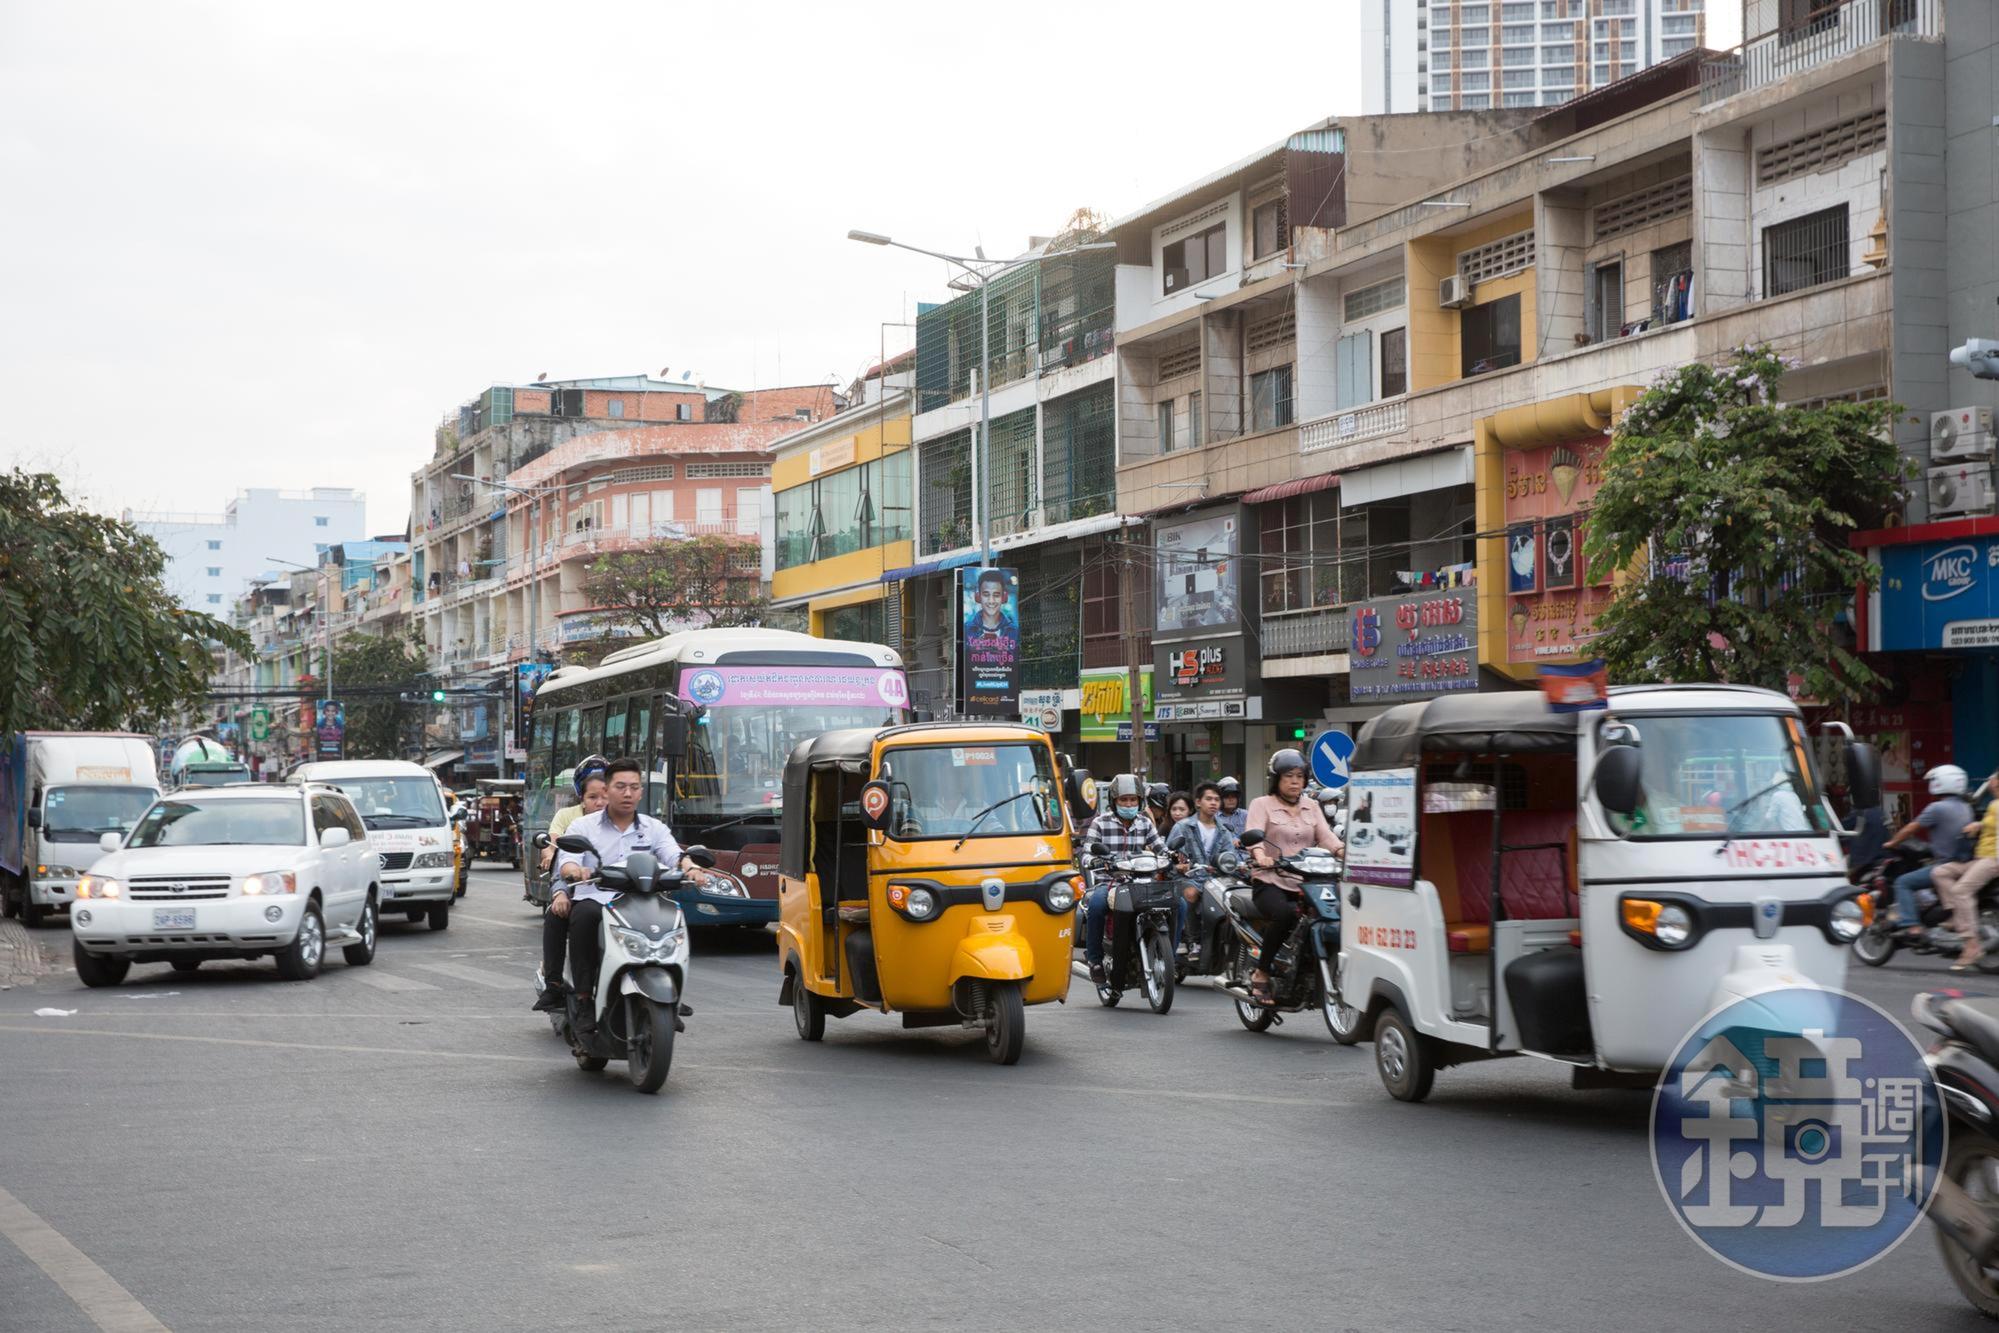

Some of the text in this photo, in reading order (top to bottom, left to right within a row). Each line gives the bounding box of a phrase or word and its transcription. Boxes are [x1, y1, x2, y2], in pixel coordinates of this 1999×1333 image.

[1931, 556, 1971, 581] MKC
[1169, 646, 1222, 677] HS plus
[884, 678, 904, 697] 4A
[1157, 707, 1171, 718] JTS
